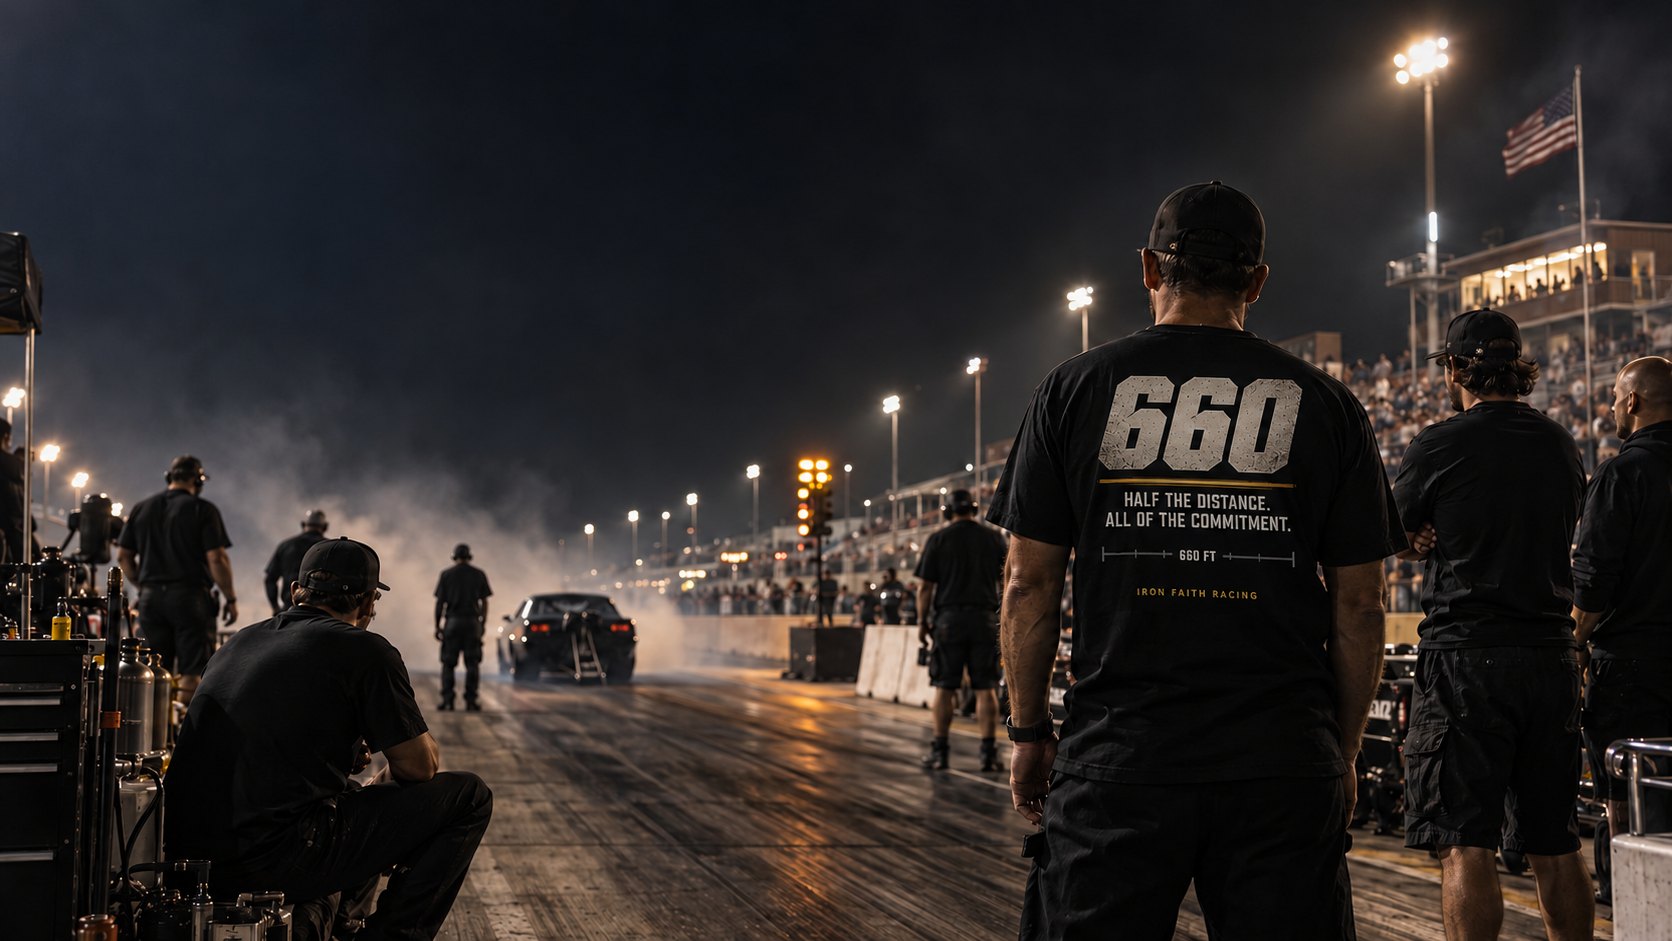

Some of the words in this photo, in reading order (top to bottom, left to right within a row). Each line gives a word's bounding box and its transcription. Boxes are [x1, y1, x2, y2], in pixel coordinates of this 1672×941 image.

[1098, 375, 1303, 474] 660
[1124, 491, 1159, 508] HALF
[1165, 492, 1192, 508] THE
[1197, 493, 1271, 511] DISTANCE.
[1105, 511, 1132, 528] ALL
[1136, 511, 1154, 528] OF
[1158, 512, 1186, 528] THE
[1191, 513, 1292, 532] COMMITMENT.
[1179, 549, 1200, 562] 660
[1203, 550, 1217, 562] FT
[1136, 587, 1165, 596] IRON
[1171, 588, 1206, 598] FAITH
[1212, 590, 1258, 600] RACING
